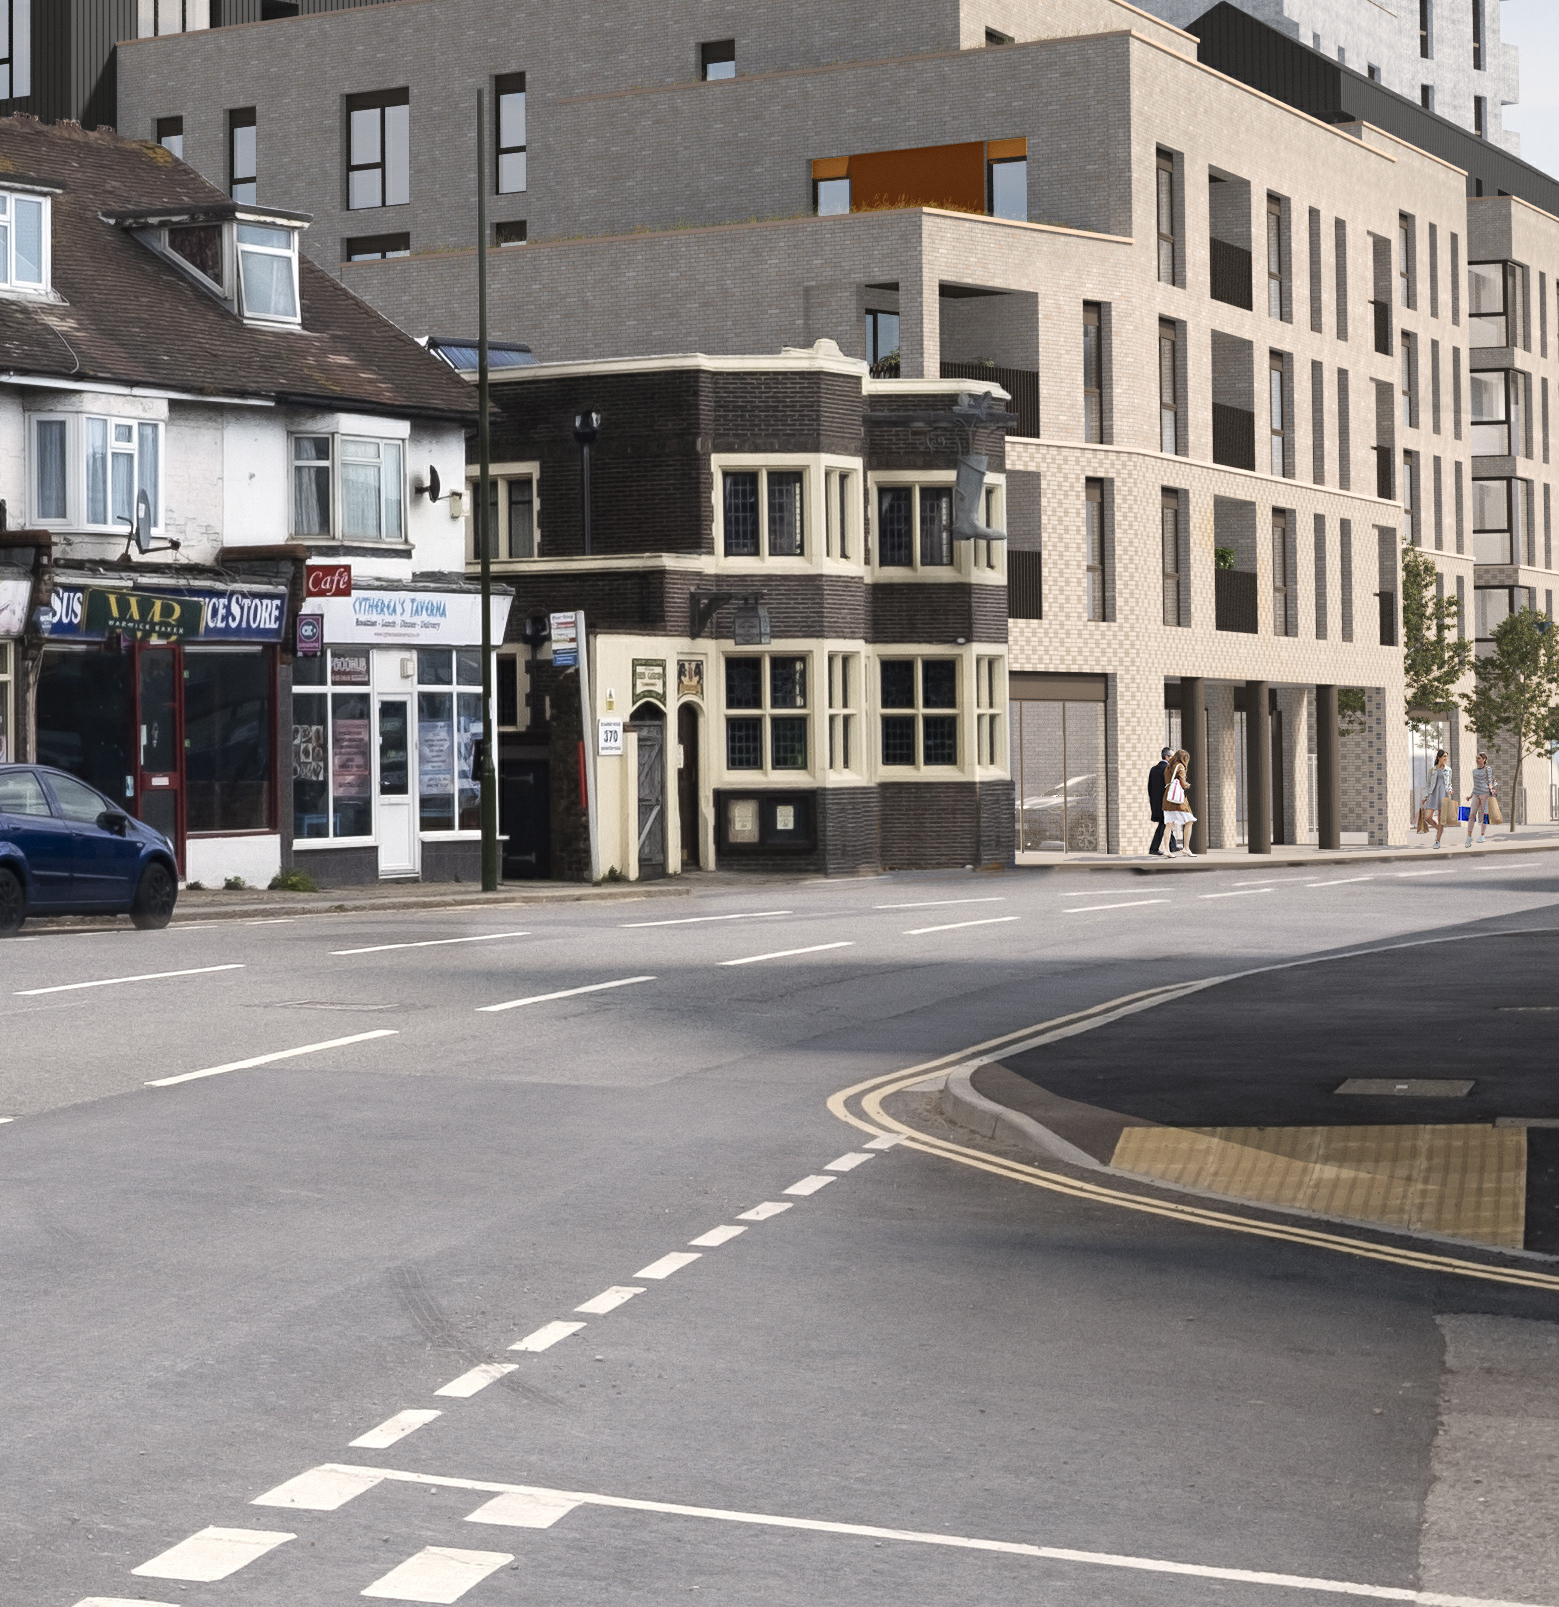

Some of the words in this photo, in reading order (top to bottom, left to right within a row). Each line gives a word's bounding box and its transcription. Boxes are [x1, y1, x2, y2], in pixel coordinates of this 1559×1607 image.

[228, 593, 282, 629] STORE
[108, 620, 151, 630] WARWICK
[604, 729, 619, 743] 370
